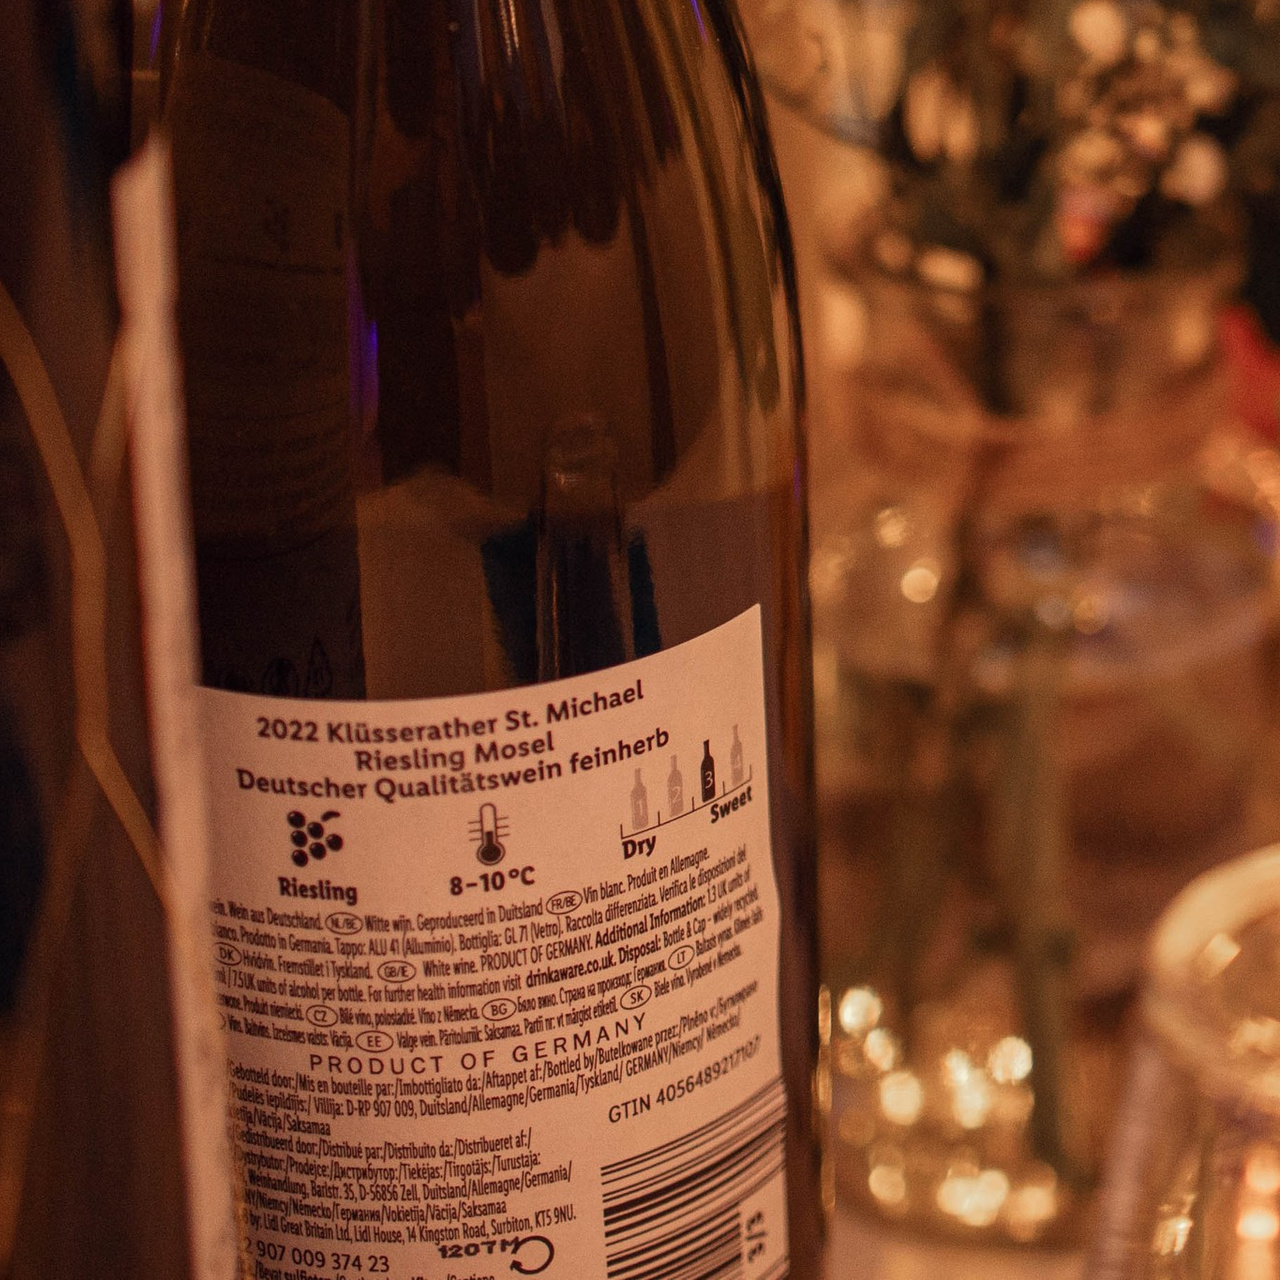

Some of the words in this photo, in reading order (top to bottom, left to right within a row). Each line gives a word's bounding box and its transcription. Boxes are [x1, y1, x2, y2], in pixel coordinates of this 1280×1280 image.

[257, 717, 318, 742] 2022
[327, 717, 497, 743] Klüsserather
[505, 710, 538, 731] St.
[547, 679, 644, 725] Michael
[236, 769, 367, 799] Deutscher
[374, 761, 562, 803] Qualitätswein
[570, 727, 669, 774] feinherb
[355, 748, 465, 772] Riesling
[474, 732, 554, 764] Mosel
[704, 771, 714, 789] 3
[710, 787, 752, 824] Sweet
[622, 836, 657, 860] Dry
[278, 877, 358, 906] Riesling
[365, 915, 390, 932] Witte
[417, 911, 484, 936] Geproduceerd
[487, 907, 495, 924] in
[498, 898, 543, 922] Duitsland
[551, 895, 577, 910] FR/BE
[583, 886, 598, 904] Vin
[600, 881, 626, 900] blanc.
[627, 867, 657, 891] Produit
[659, 866, 669, 880] en
[670, 847, 710, 872] Allemagne.
[278, 932, 286, 946] in
[289, 934, 333, 955] Germania.
[369, 938, 387, 956] ALU
[459, 931, 502, 953] Bottiglia:
[504, 928, 517, 945] GL
[530, 916, 563, 944] (Vetro).
[565, 909, 602, 932] Raccolta
[605, 893, 658, 921] differenziata.
[660, 881, 688, 902] Verifica
[689, 875, 696, 889] le
[219, 947, 235, 962] DK
[332, 961, 373, 982] Tyskland.
[423, 960, 451, 977] White
[453, 958, 478, 974] wine.
[480, 948, 527, 971] PRODUCT
[531, 945, 543, 964] OF
[546, 934, 593, 961] GERMANY.
[595, 923, 648, 948] Additional
[650, 896, 706, 930] Information:
[676, 951, 686, 965] LT
[278, 978, 287, 995] of
[289, 979, 320, 1000] alcohol
[321, 987, 336, 1003] per
[337, 984, 366, 1002] bottle.
[368, 985, 382, 1002] For
[385, 984, 415, 1002] further
[417, 982, 445, 1001] health
[448, 978, 500, 1000] information
[502, 974, 521, 992] visit
[526, 953, 616, 988] drinkaware.co.uk.
[618, 937, 661, 964] Disposal:
[663, 927, 685, 949] Bottle
[686, 922, 692, 938] &
[692, 916, 706, 936] Cap
[313, 1010, 327, 1022] CZ
[491, 1004, 508, 1017] BG
[366, 1035, 381, 1048] EE
[630, 990, 644, 1004] SK
[310, 1054, 443, 1075] PRODUCT
[461, 1050, 495, 1070] OF
[512, 1012, 646, 1063] GERMANY
[317, 1080, 328, 1094] en
[331, 1076, 372, 1096] bouteille
[346, 1100, 371, 1117] D-RP
[373, 1101, 391, 1118] 907
[394, 1100, 417, 1119] 009,
[609, 1095, 651, 1123] GTIN
[311, 1180, 342, 1199] Barlstr.
[343, 1183, 357, 1202] 35,
[359, 1184, 398, 1202] D-56856
[400, 1185, 420, 1204] Zell,
[423, 1160, 572, 1200] Duitsland/Allemagne/Germania/
[264, 1213, 278, 1232] Lidl
[280, 1217, 303, 1236] Great
[305, 1220, 333, 1239] Britain
[335, 1224, 352, 1244] Ltd,
[354, 1225, 371, 1242] Lidl
[374, 1226, 405, 1245] House,
[406, 1226, 416, 1241] 14
[419, 1224, 459, 1245] Kingston
[462, 1221, 489, 1240] Road,
[491, 1213, 533, 1235] Surbiton,
[535, 1209, 552, 1228] KT5
[553, 1203, 577, 1224] 9NU.
[257, 1240, 285, 1261] 907
[292, 1248, 326, 1268] 009
[331, 1253, 363, 1271] 374
[368, 1255, 390, 1273] 23
